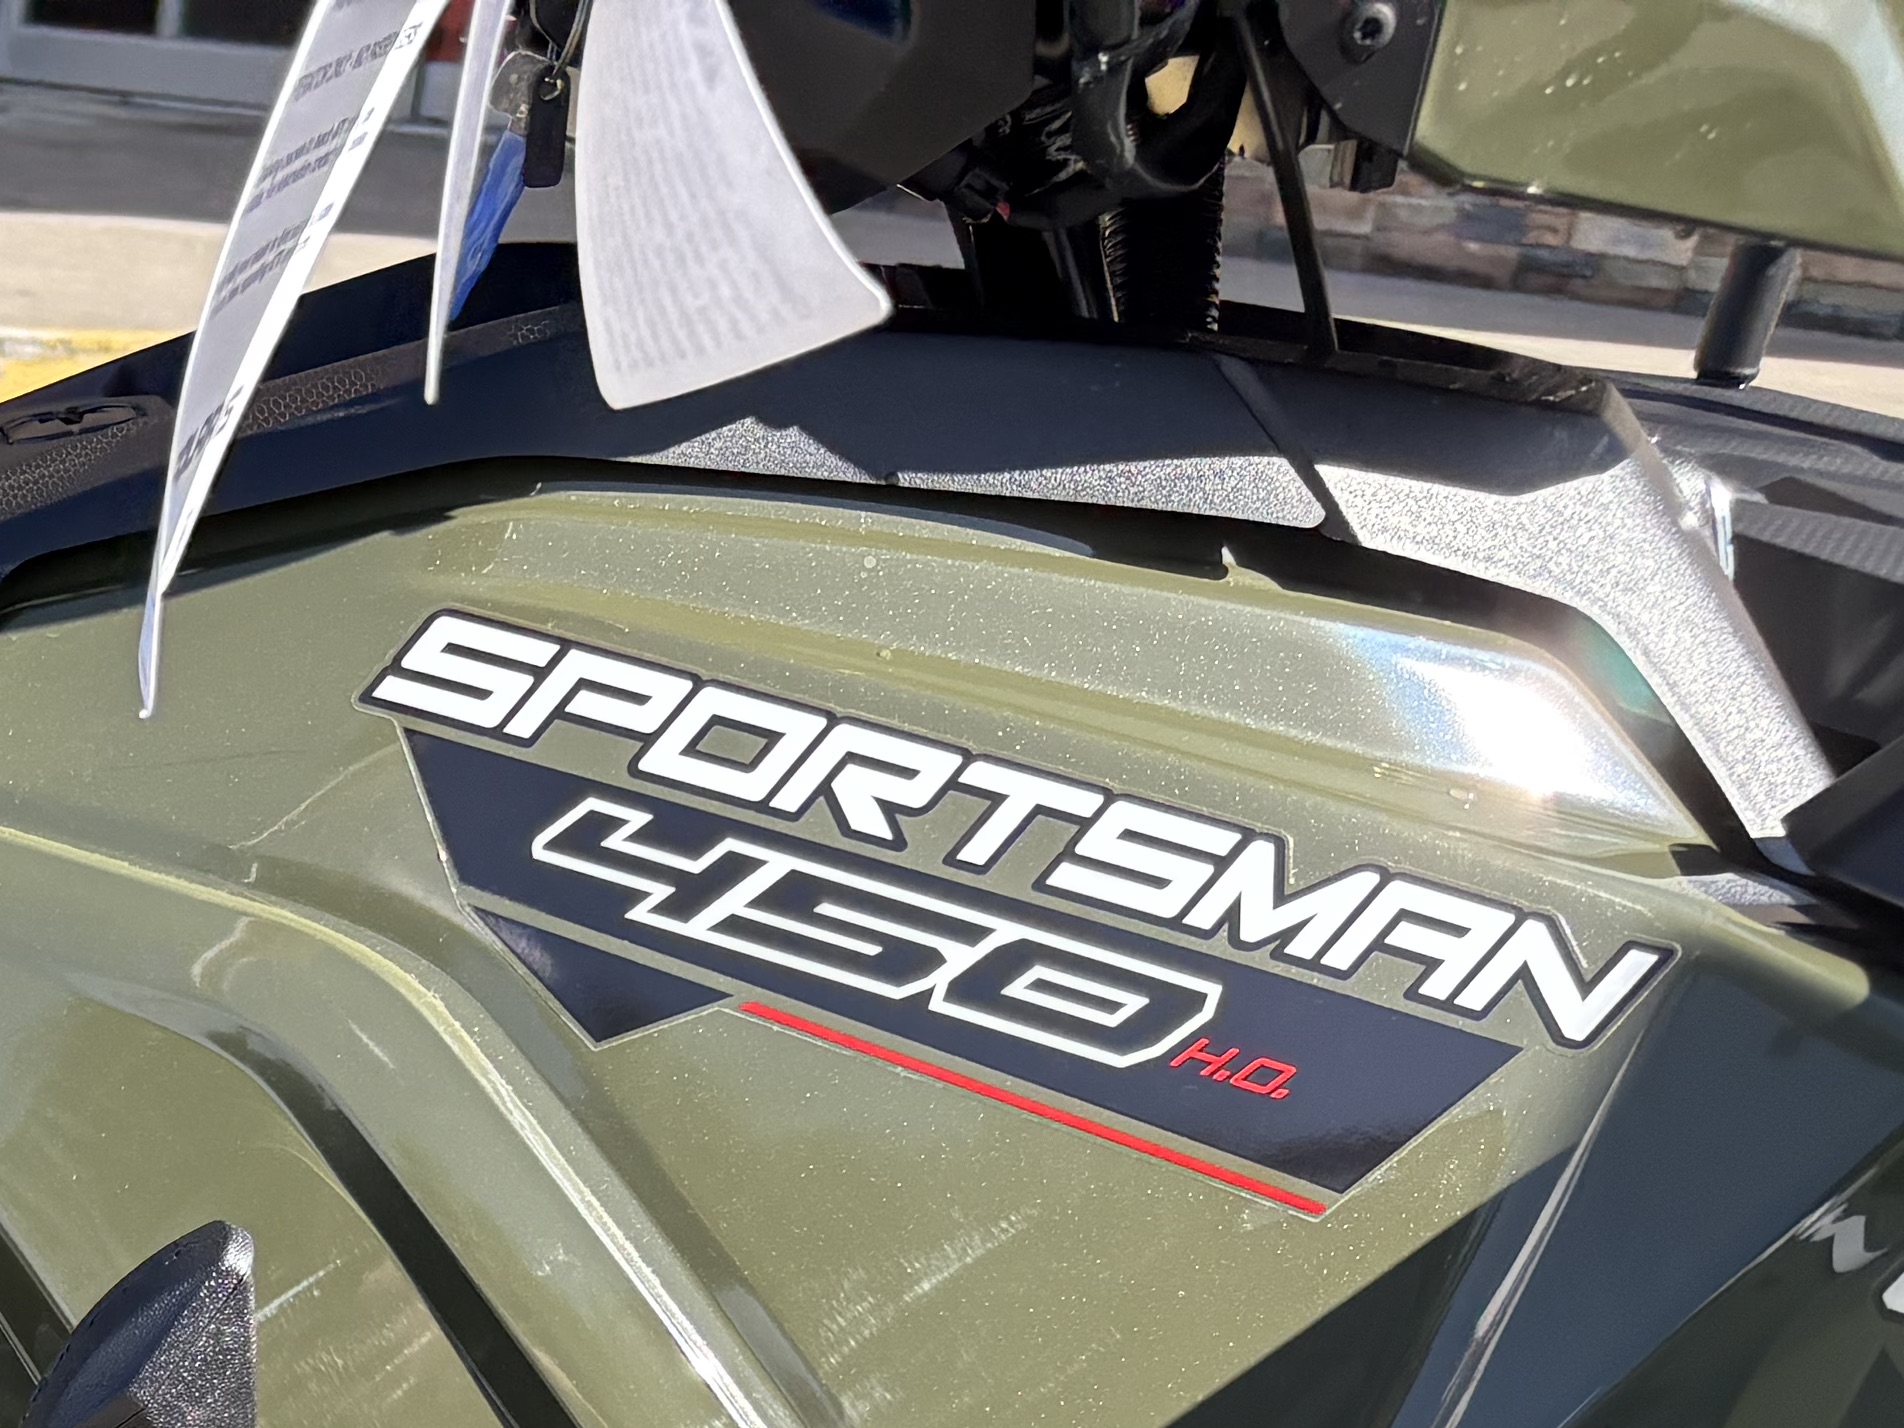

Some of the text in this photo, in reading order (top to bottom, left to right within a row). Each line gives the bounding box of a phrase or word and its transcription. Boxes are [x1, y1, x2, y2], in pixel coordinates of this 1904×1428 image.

[371, 613, 1660, 1042] SPORTSMAN
[531, 798, 1299, 1104] 450 H.O.
